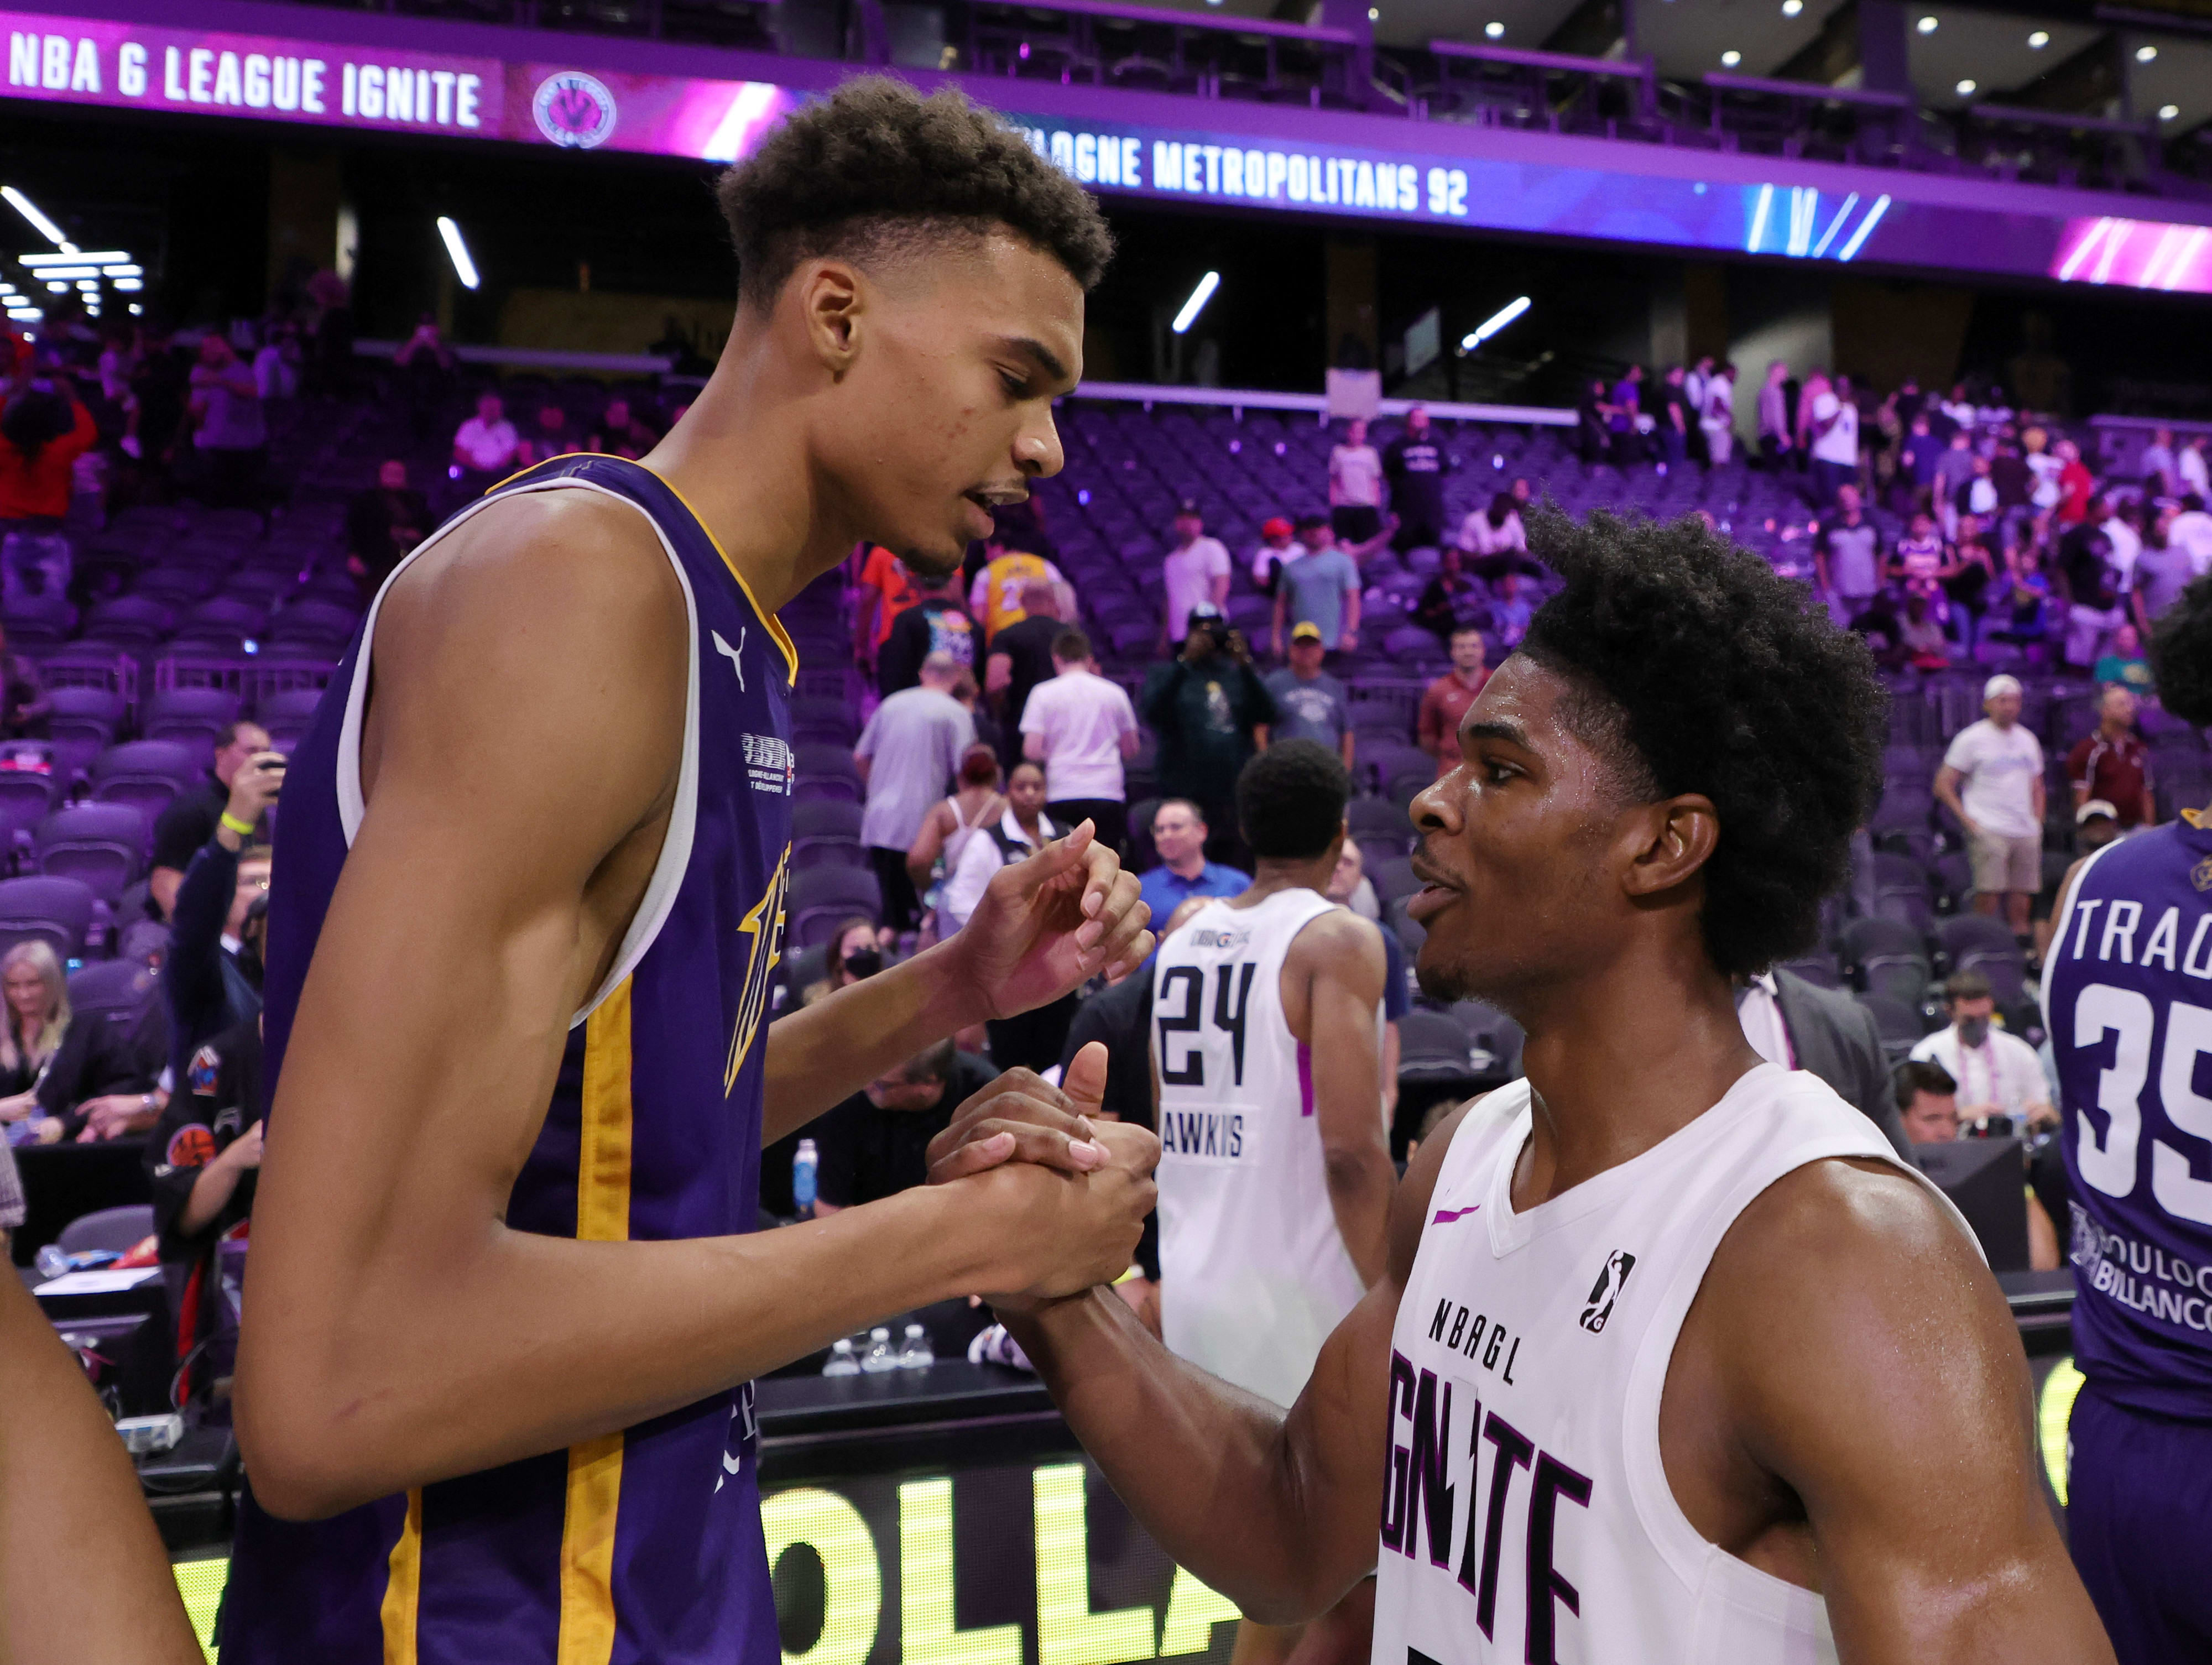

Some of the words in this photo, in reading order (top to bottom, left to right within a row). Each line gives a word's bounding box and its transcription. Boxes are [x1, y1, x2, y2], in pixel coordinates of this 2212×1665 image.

[8, 32, 101, 93] NBA
[117, 42, 147, 96] G
[164, 46, 326, 113] LEAGUE
[342, 62, 479, 127] IGNITE
[1152, 139, 1418, 211] METROPOLITANS
[1427, 167, 1468, 216] 92
[1158, 962, 1256, 1087] 24
[2075, 983, 2212, 1224] 35
[1428, 1298, 1520, 1386] NBAGL
